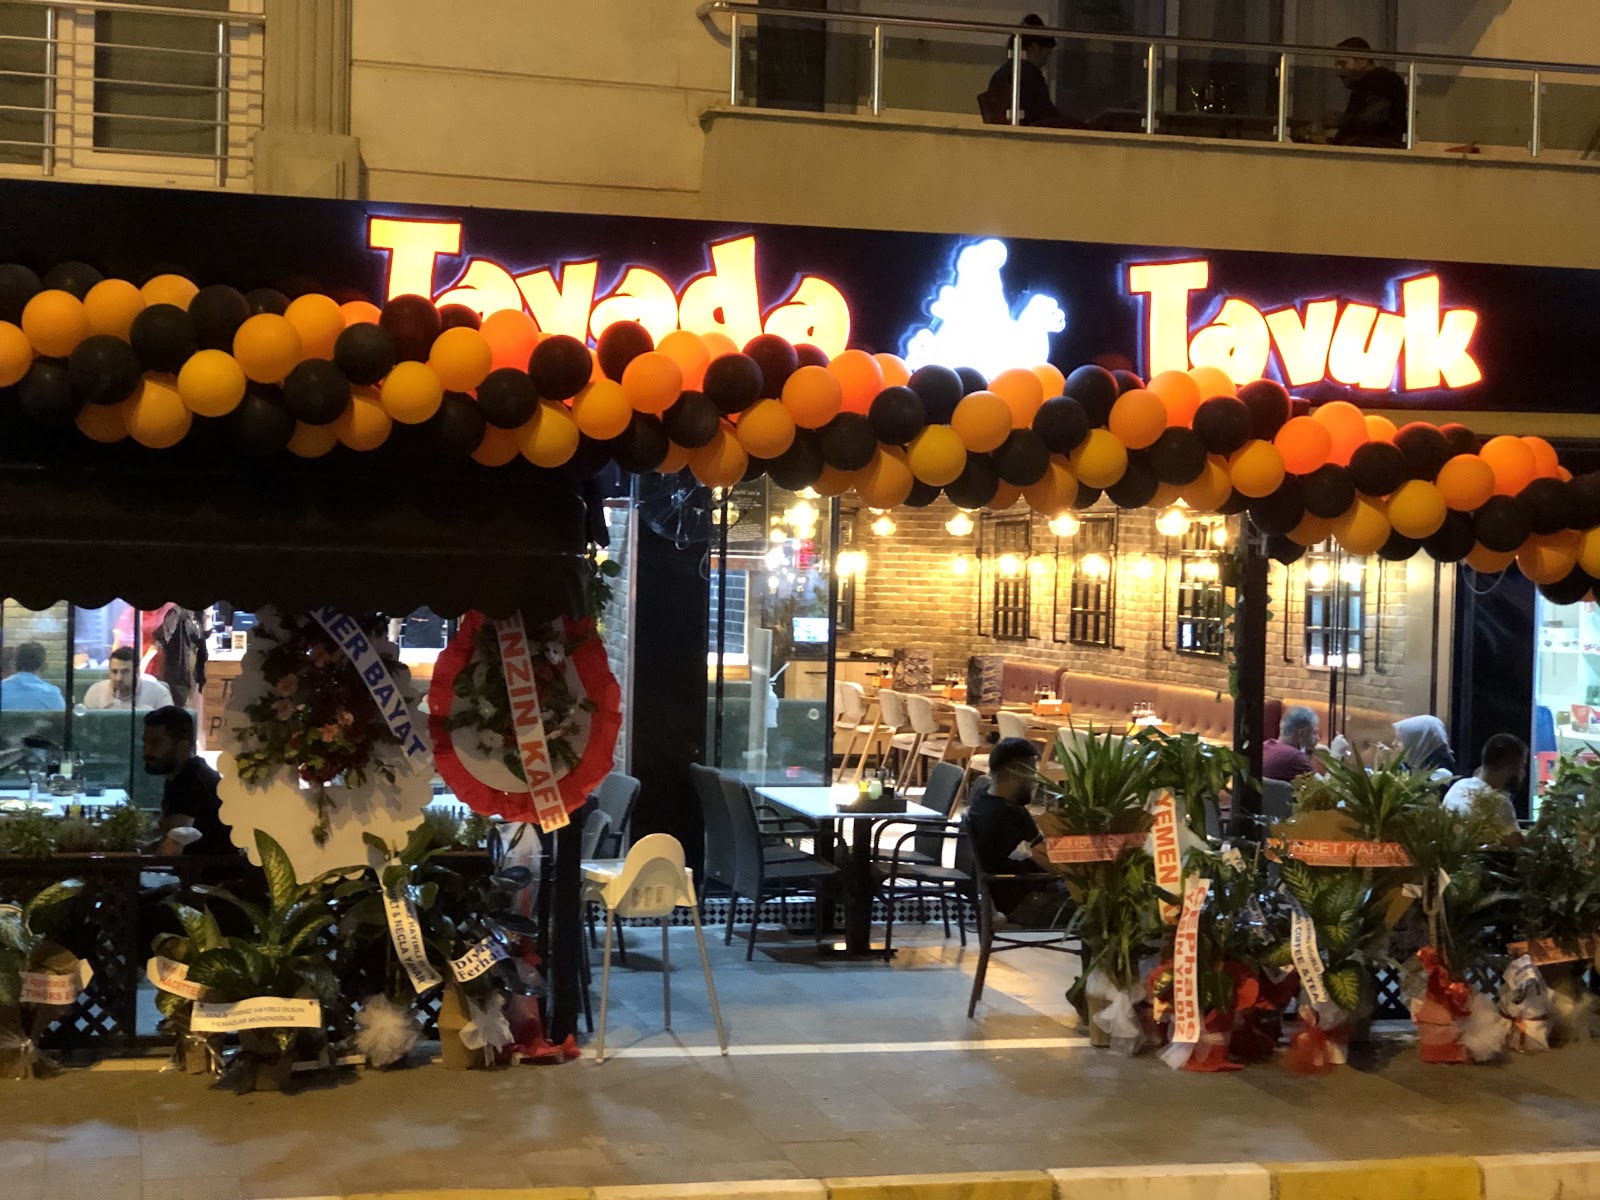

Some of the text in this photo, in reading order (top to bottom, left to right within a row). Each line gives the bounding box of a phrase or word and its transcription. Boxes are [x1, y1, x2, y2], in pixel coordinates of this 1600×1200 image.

[366, 215, 1483, 391] Tavada Tavuk
[363, 661, 427, 757] BAYAT
[519, 740, 565, 830] KAFE
[1154, 792, 1179, 884] YEMEN
[394, 918, 409, 955] NECLA
[408, 921, 421, 959] HAYIRLI
[1306, 977, 1319, 1001] TEA
